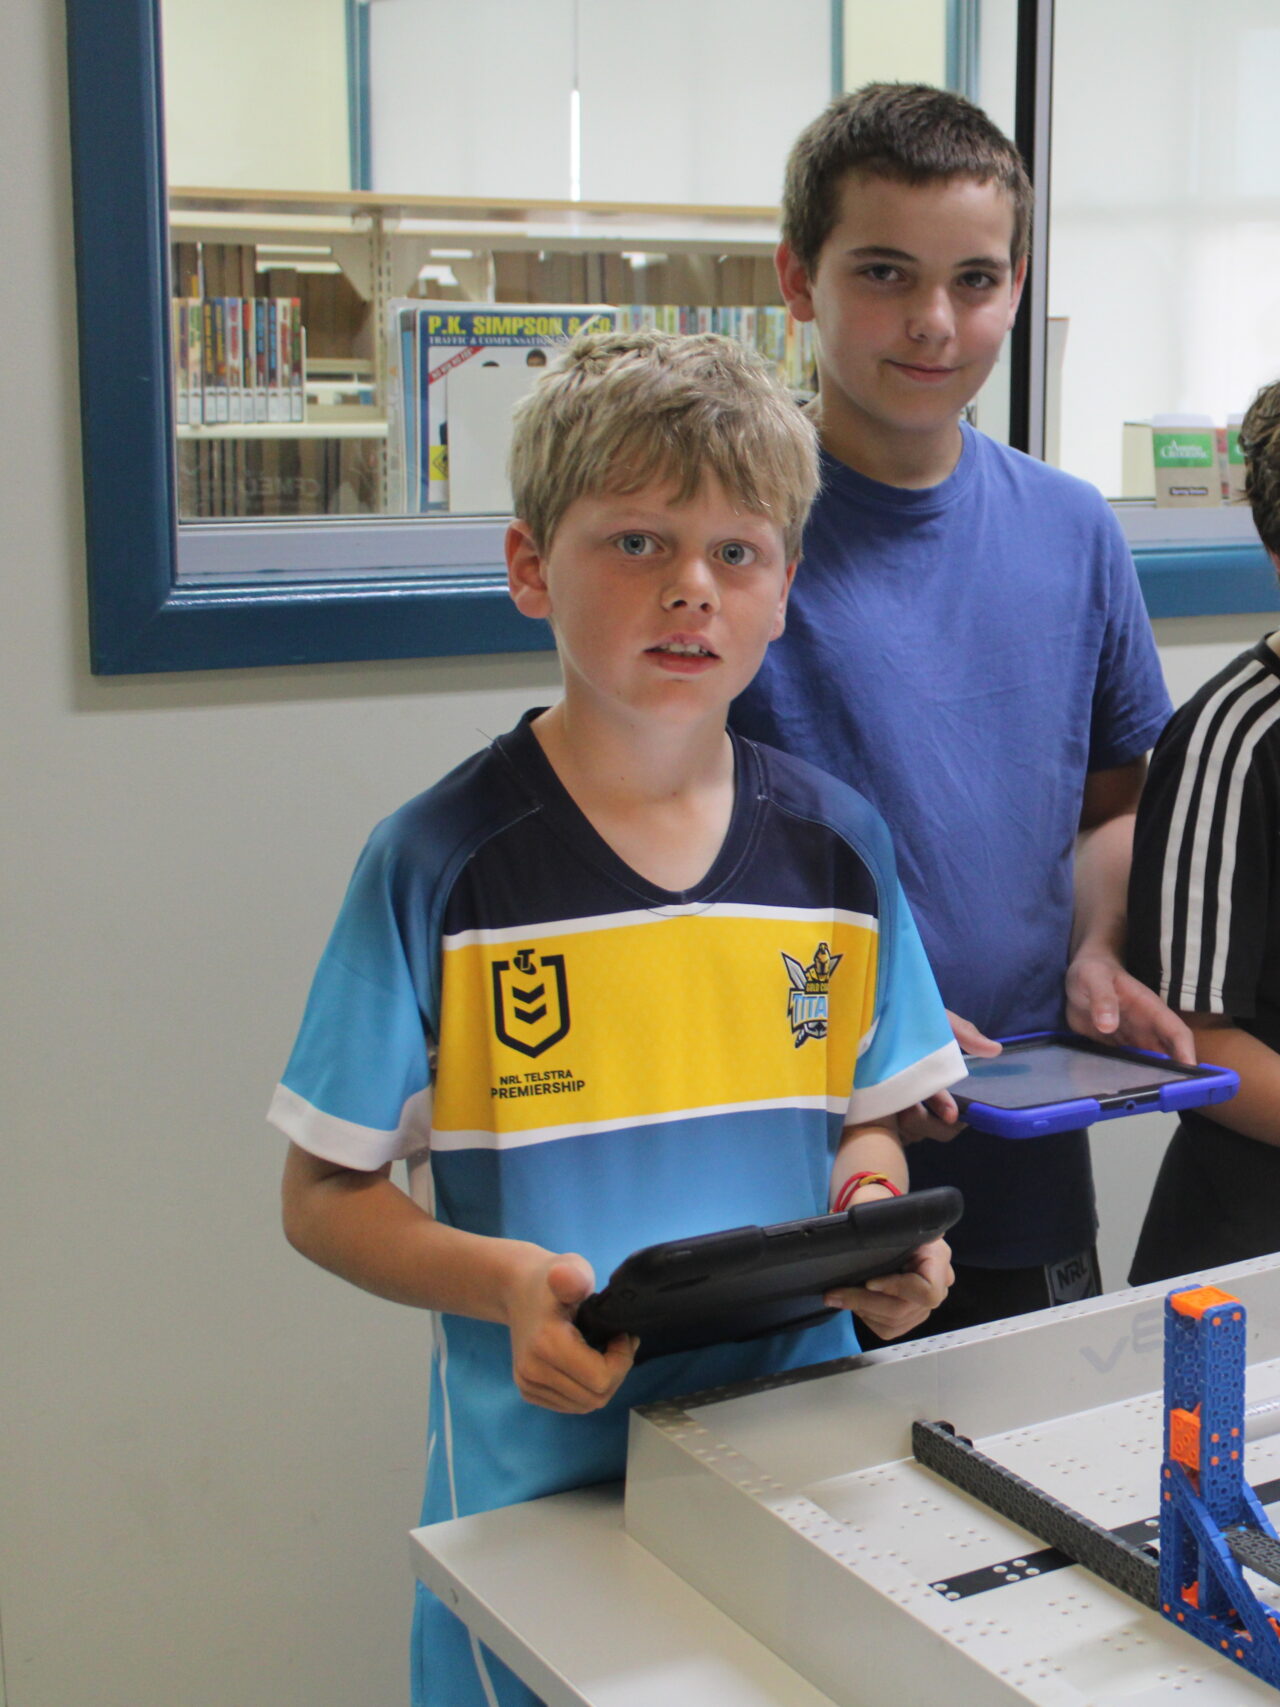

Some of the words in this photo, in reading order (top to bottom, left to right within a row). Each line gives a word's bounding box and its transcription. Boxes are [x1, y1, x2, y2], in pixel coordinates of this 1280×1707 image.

[427, 315, 467, 335] P.K.
[472, 316, 563, 335] SIMPSON
[429, 336, 467, 345] TRAFFIC
[793, 993, 828, 1025] TITA
[500, 1075, 522, 1085] NRL
[524, 1069, 573, 1082] TELSTRA
[490, 1080, 586, 1099] PREMIERSHIP
[1056, 1259, 1088, 1290] NRL
[1079, 1308, 1163, 1374] VE
